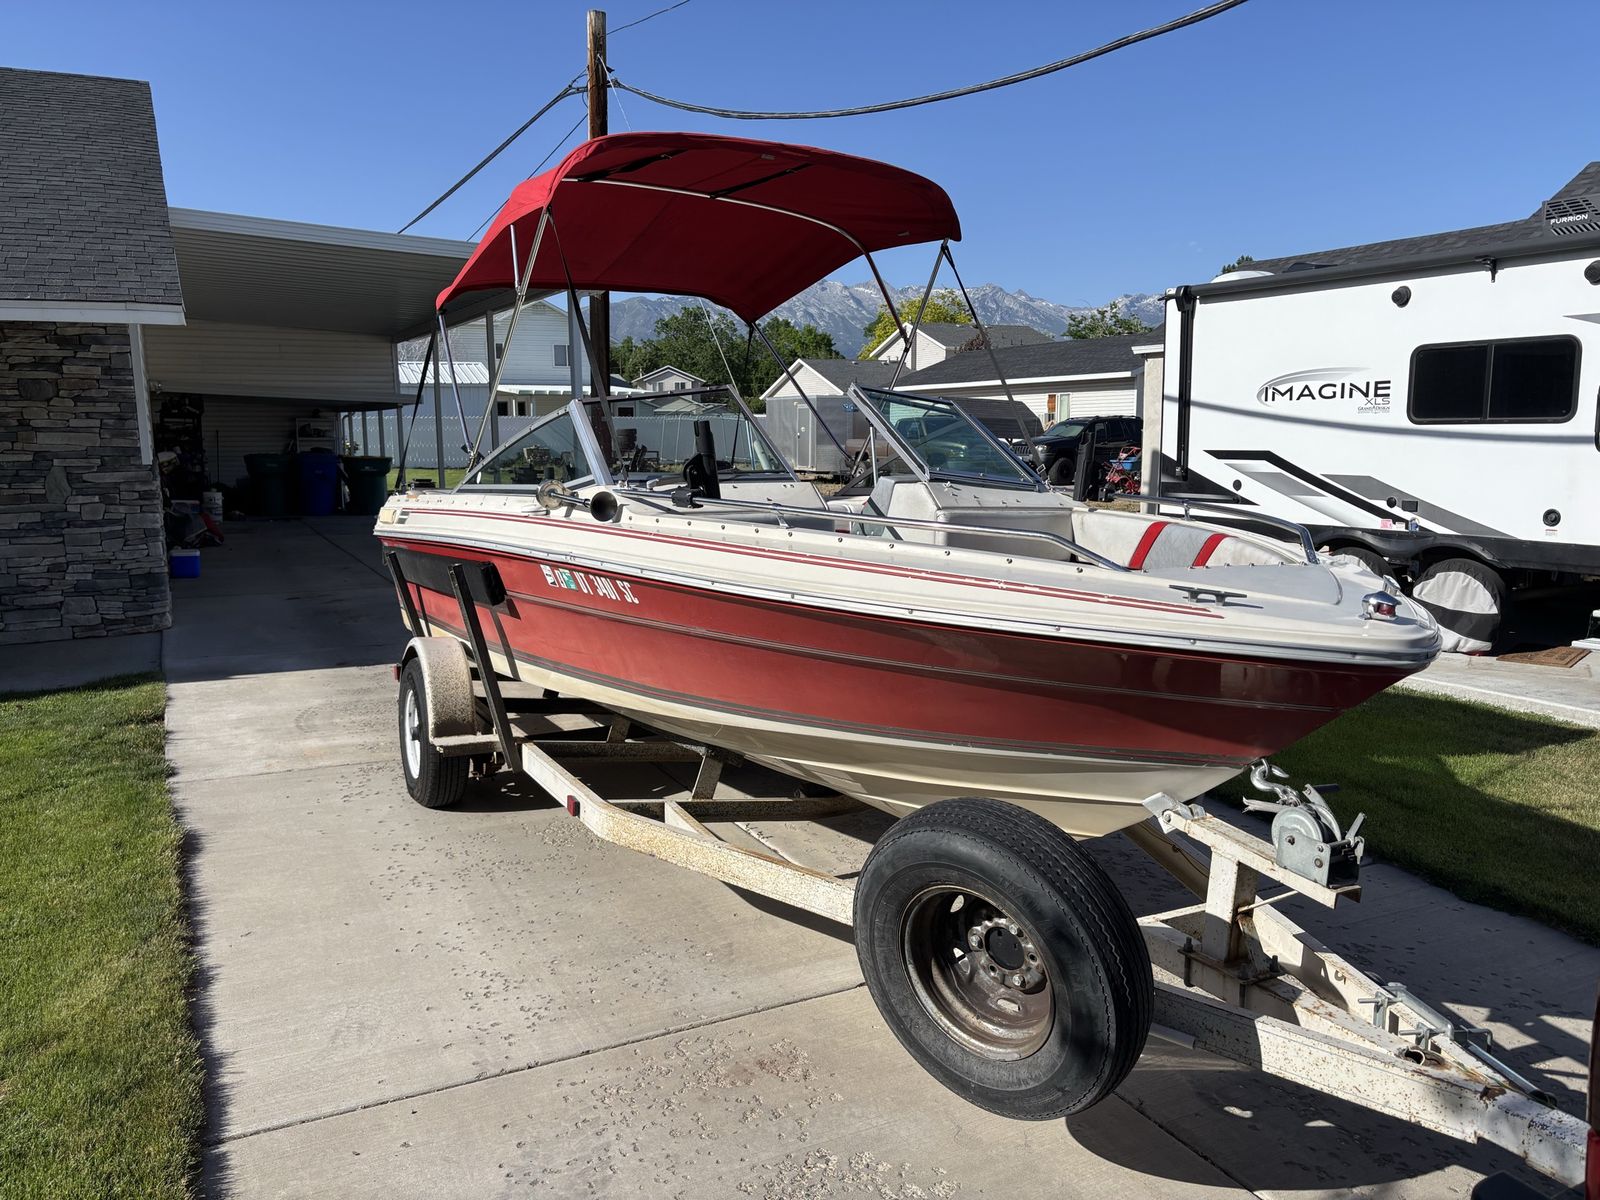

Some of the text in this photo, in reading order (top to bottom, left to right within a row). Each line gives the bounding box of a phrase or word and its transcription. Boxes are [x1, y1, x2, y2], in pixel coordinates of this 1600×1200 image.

[1550, 213, 1589, 225] FURRION
[1264, 380, 1391, 402] IMAGINE
[1364, 397, 1391, 406] XLS
[572, 570, 594, 595] UT
[615, 579, 640, 604] SC
